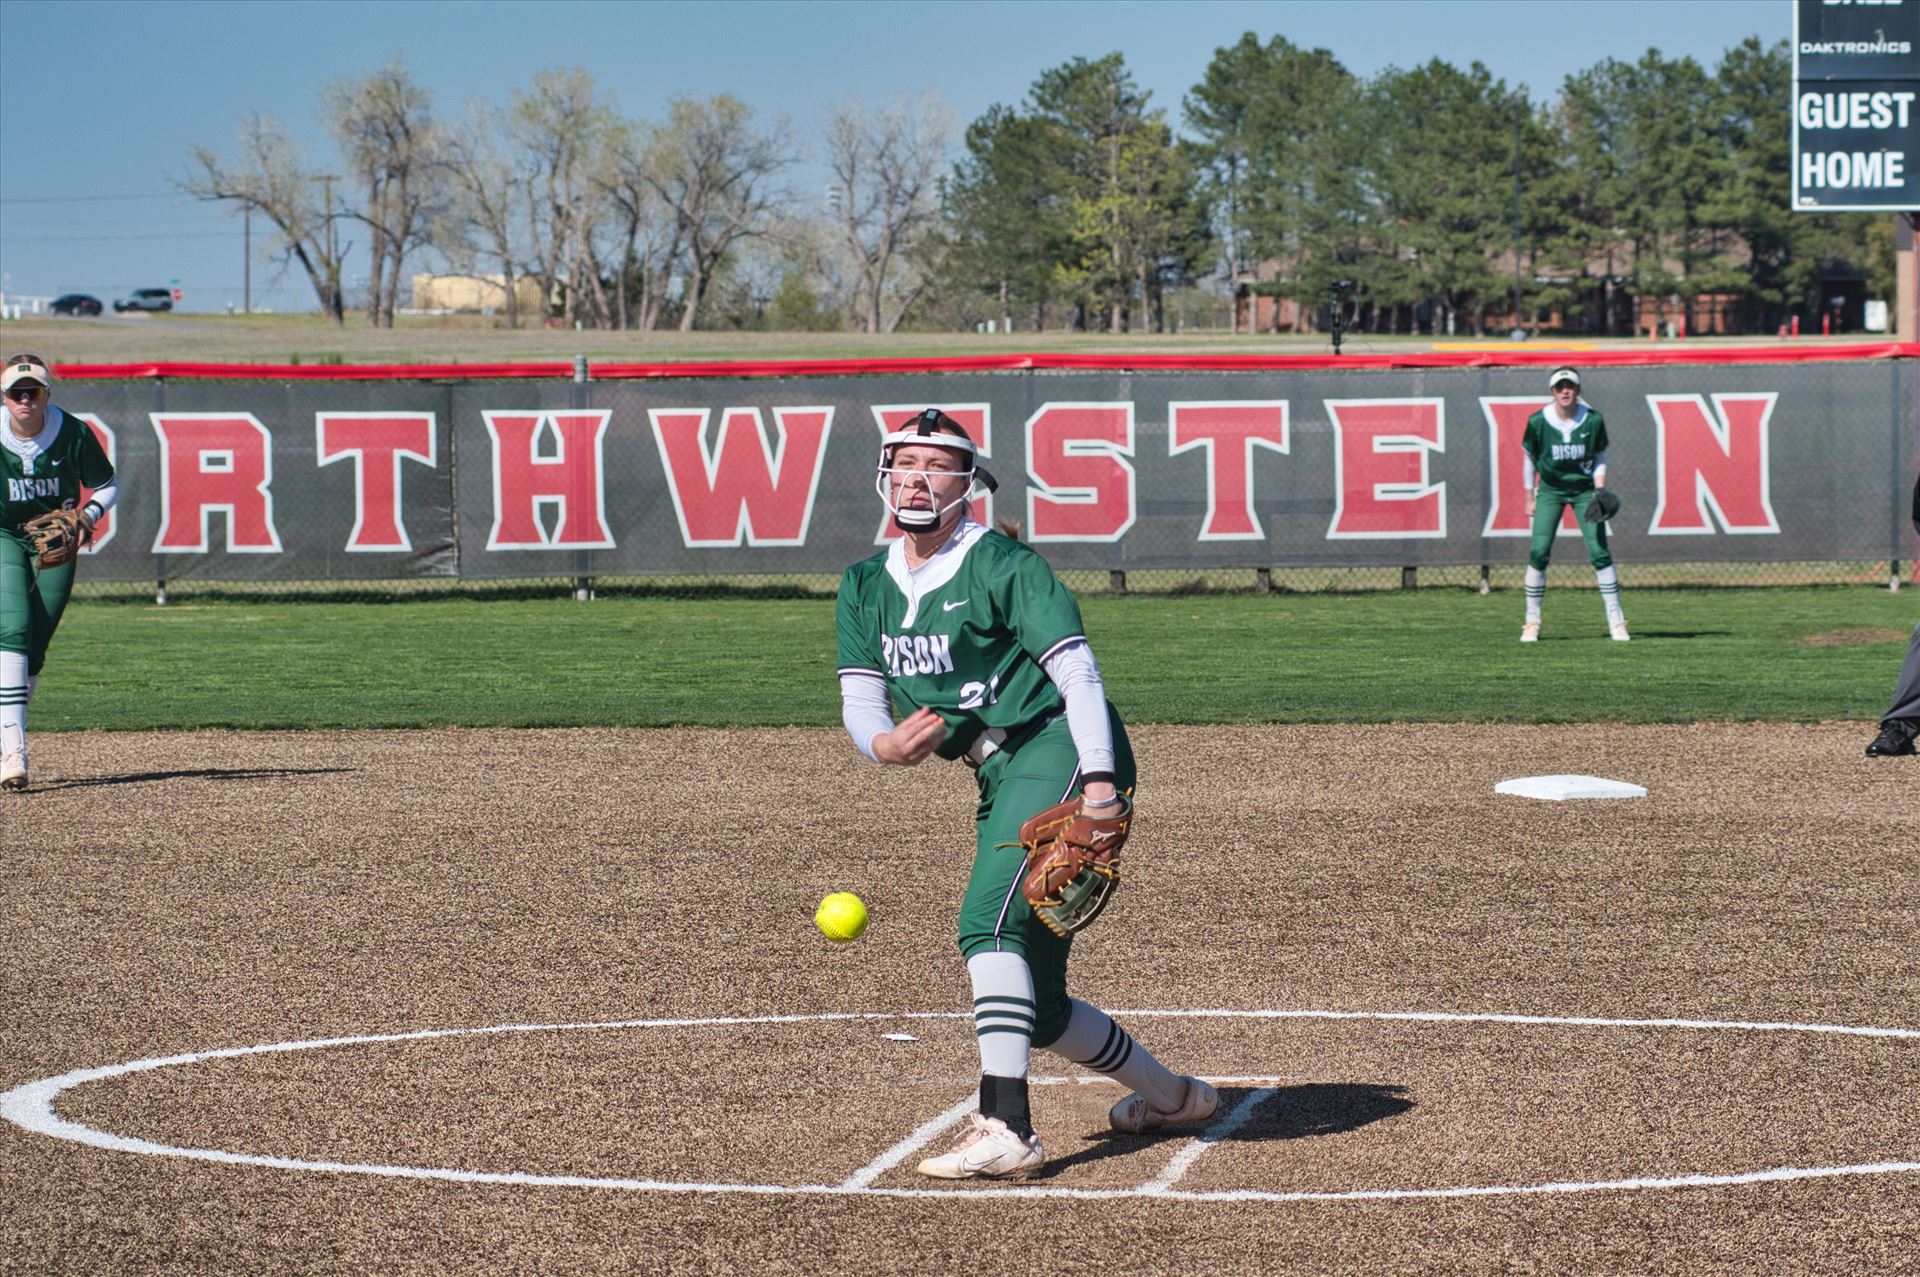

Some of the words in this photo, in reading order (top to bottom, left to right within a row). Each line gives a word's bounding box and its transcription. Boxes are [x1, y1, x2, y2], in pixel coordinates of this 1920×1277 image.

[1800, 41, 1911, 54] DAKTRONICS
[1800, 92, 1916, 129] GUEST
[1802, 152, 1905, 188] HOME
[1551, 444, 1586, 461] BISON
[70, 391, 1781, 554] RTHWSTEN
[8, 477, 60, 502] BISON
